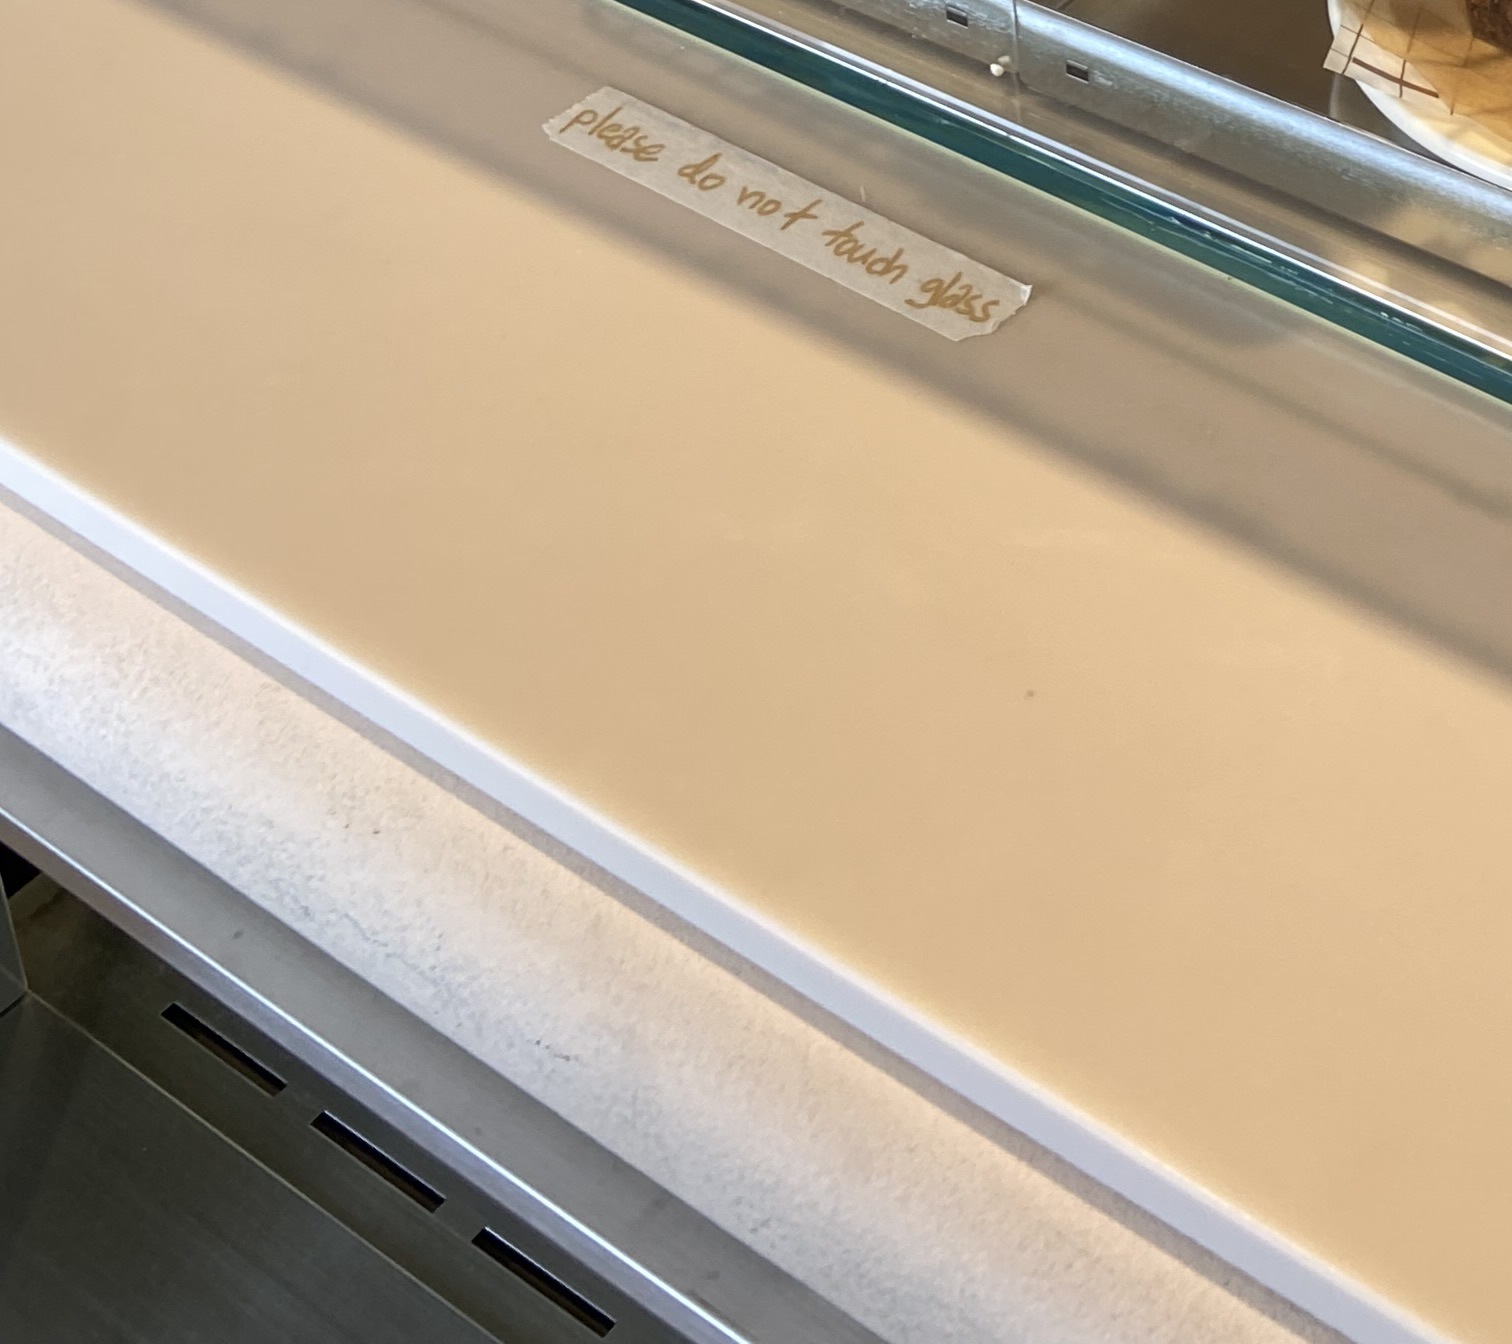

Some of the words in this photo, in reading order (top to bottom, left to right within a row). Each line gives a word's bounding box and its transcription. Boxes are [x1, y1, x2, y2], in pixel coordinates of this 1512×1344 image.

[559, 105, 666, 163] please
[677, 153, 723, 191] do
[736, 183, 818, 231] not
[822, 220, 908, 285] touch
[904, 271, 1001, 324] glass
